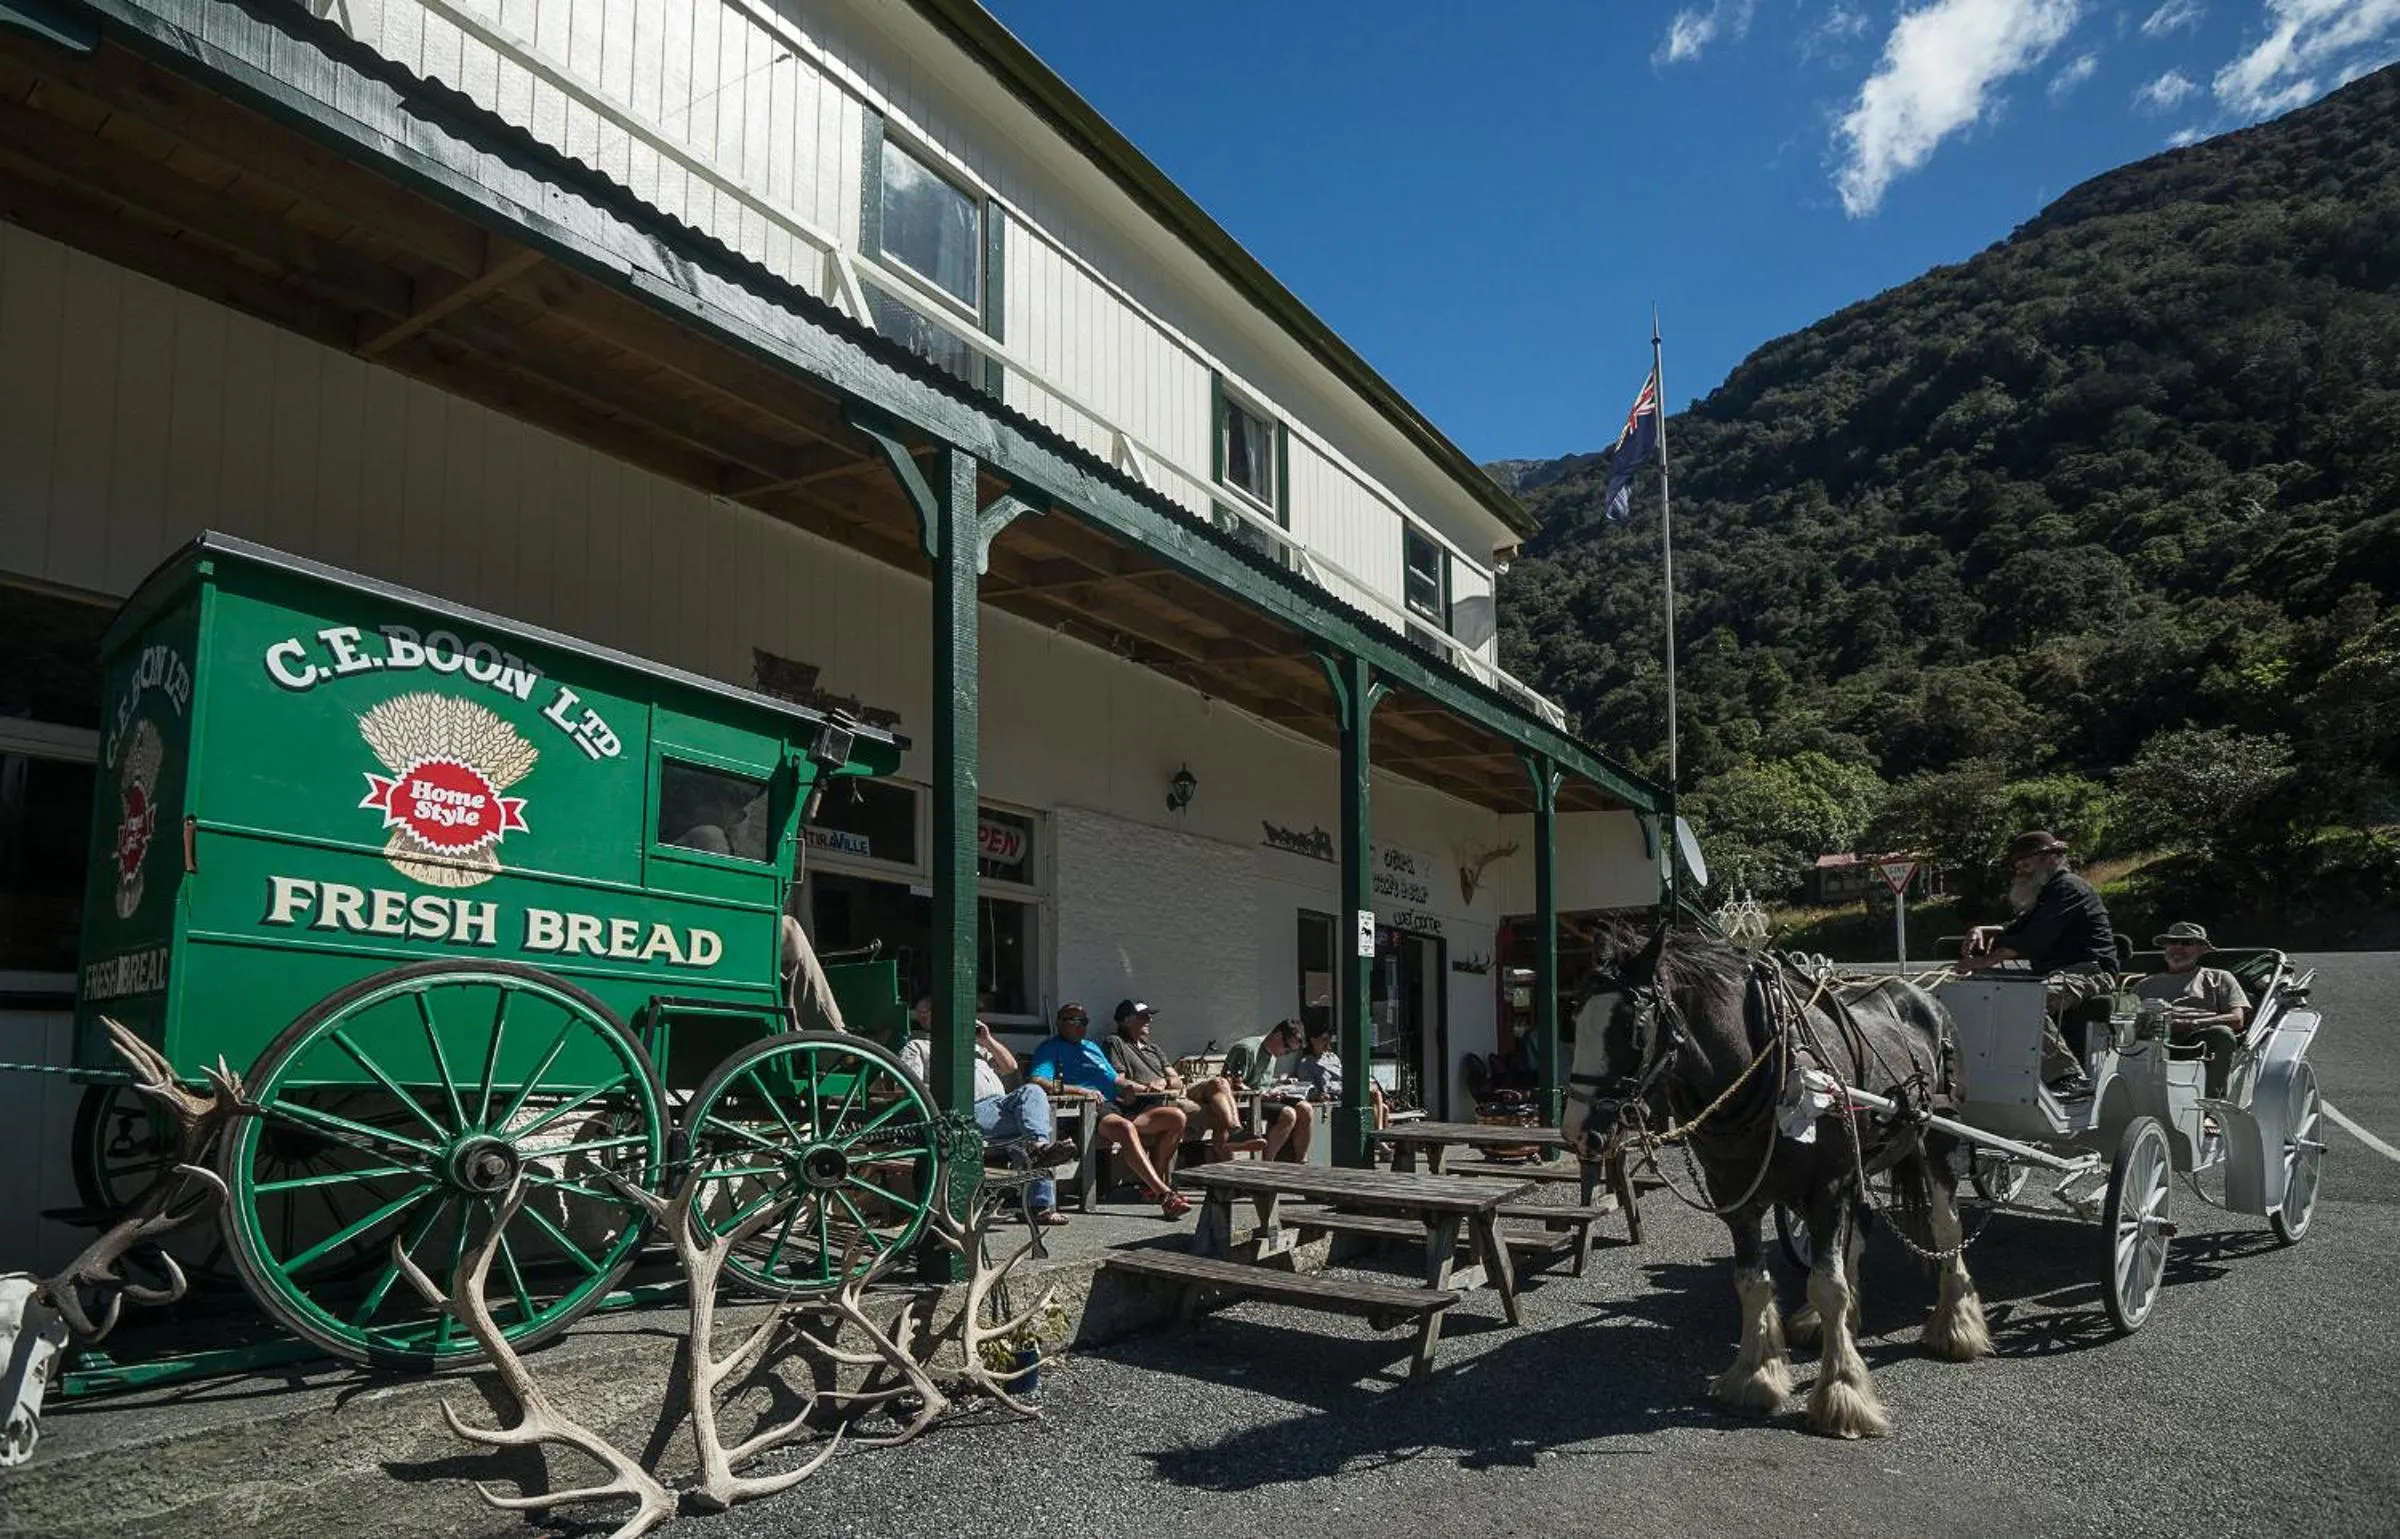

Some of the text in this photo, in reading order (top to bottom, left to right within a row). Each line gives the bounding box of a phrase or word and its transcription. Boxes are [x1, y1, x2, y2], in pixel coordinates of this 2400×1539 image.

[410, 779, 487, 809] Home
[413, 799, 481, 827] Style
[977, 824, 1022, 857] PEN
[260, 875, 724, 968] FRESH BREAD
